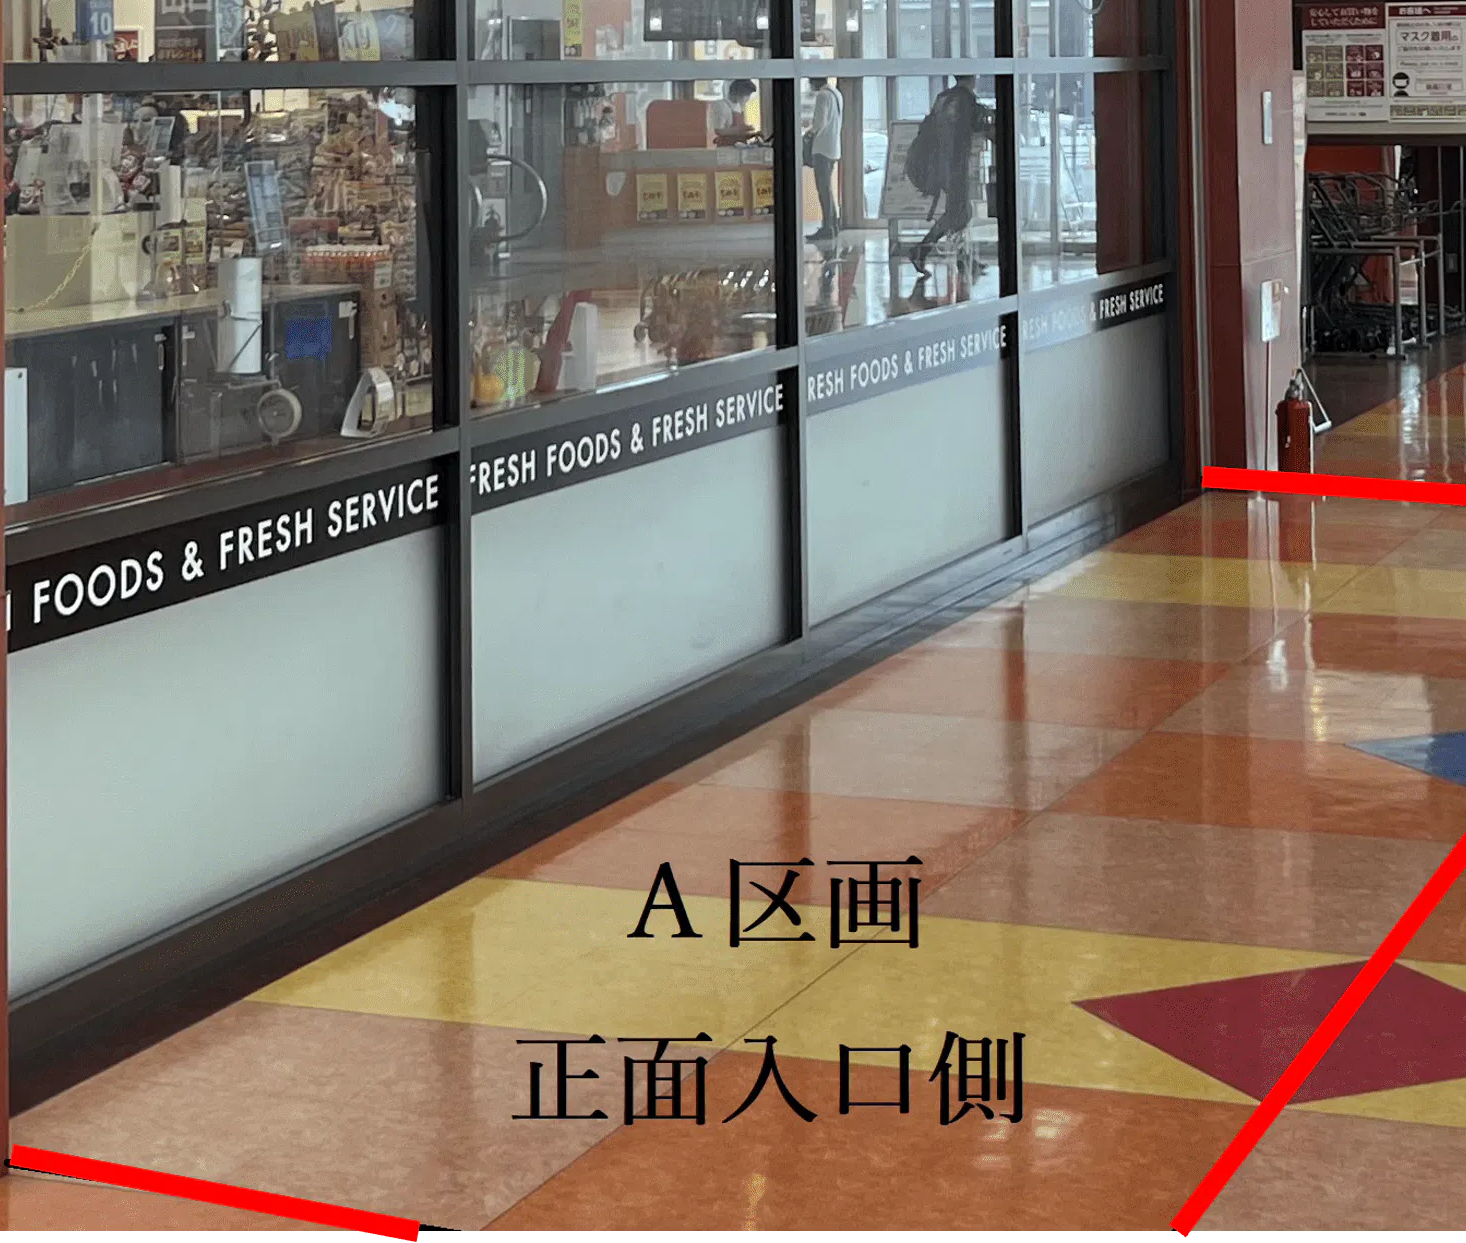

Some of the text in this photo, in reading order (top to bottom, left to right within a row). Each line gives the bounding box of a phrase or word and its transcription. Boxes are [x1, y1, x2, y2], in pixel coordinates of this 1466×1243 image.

[90, 11, 112, 36] 10
[1099, 294, 1127, 320] FRESH
[1129, 283, 1164, 312] SERVICE
[807, 324, 1007, 403] RESH FOODS & FRESH SERVICE
[544, 428, 622, 477] FOODS
[629, 421, 645, 451] &
[650, 402, 709, 444] FRESH
[715, 384, 785, 428] SERVICE
[33, 547, 165, 628] FOODS
[180, 537, 206, 584] &
[217, 506, 316, 568] FRESH
[326, 472, 441, 540] SERVICE
